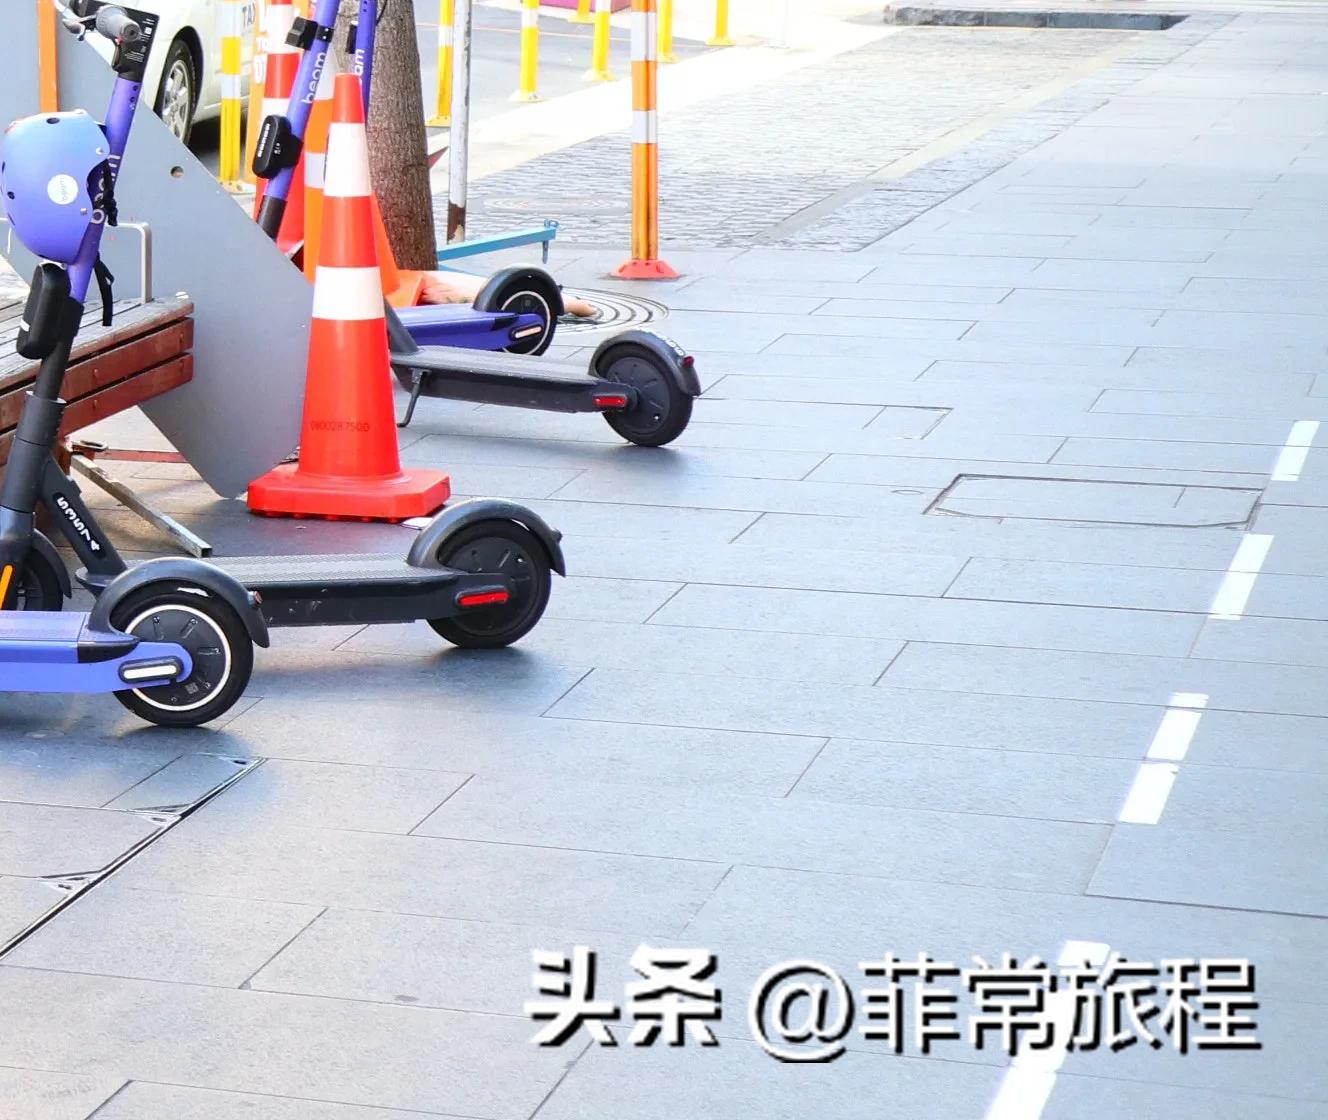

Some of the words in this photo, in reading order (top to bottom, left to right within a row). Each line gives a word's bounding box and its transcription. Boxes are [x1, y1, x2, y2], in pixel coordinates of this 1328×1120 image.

[301, 51, 328, 105] beam
[353, 48, 366, 86] am
[57, 497, 101, 551] 53574
